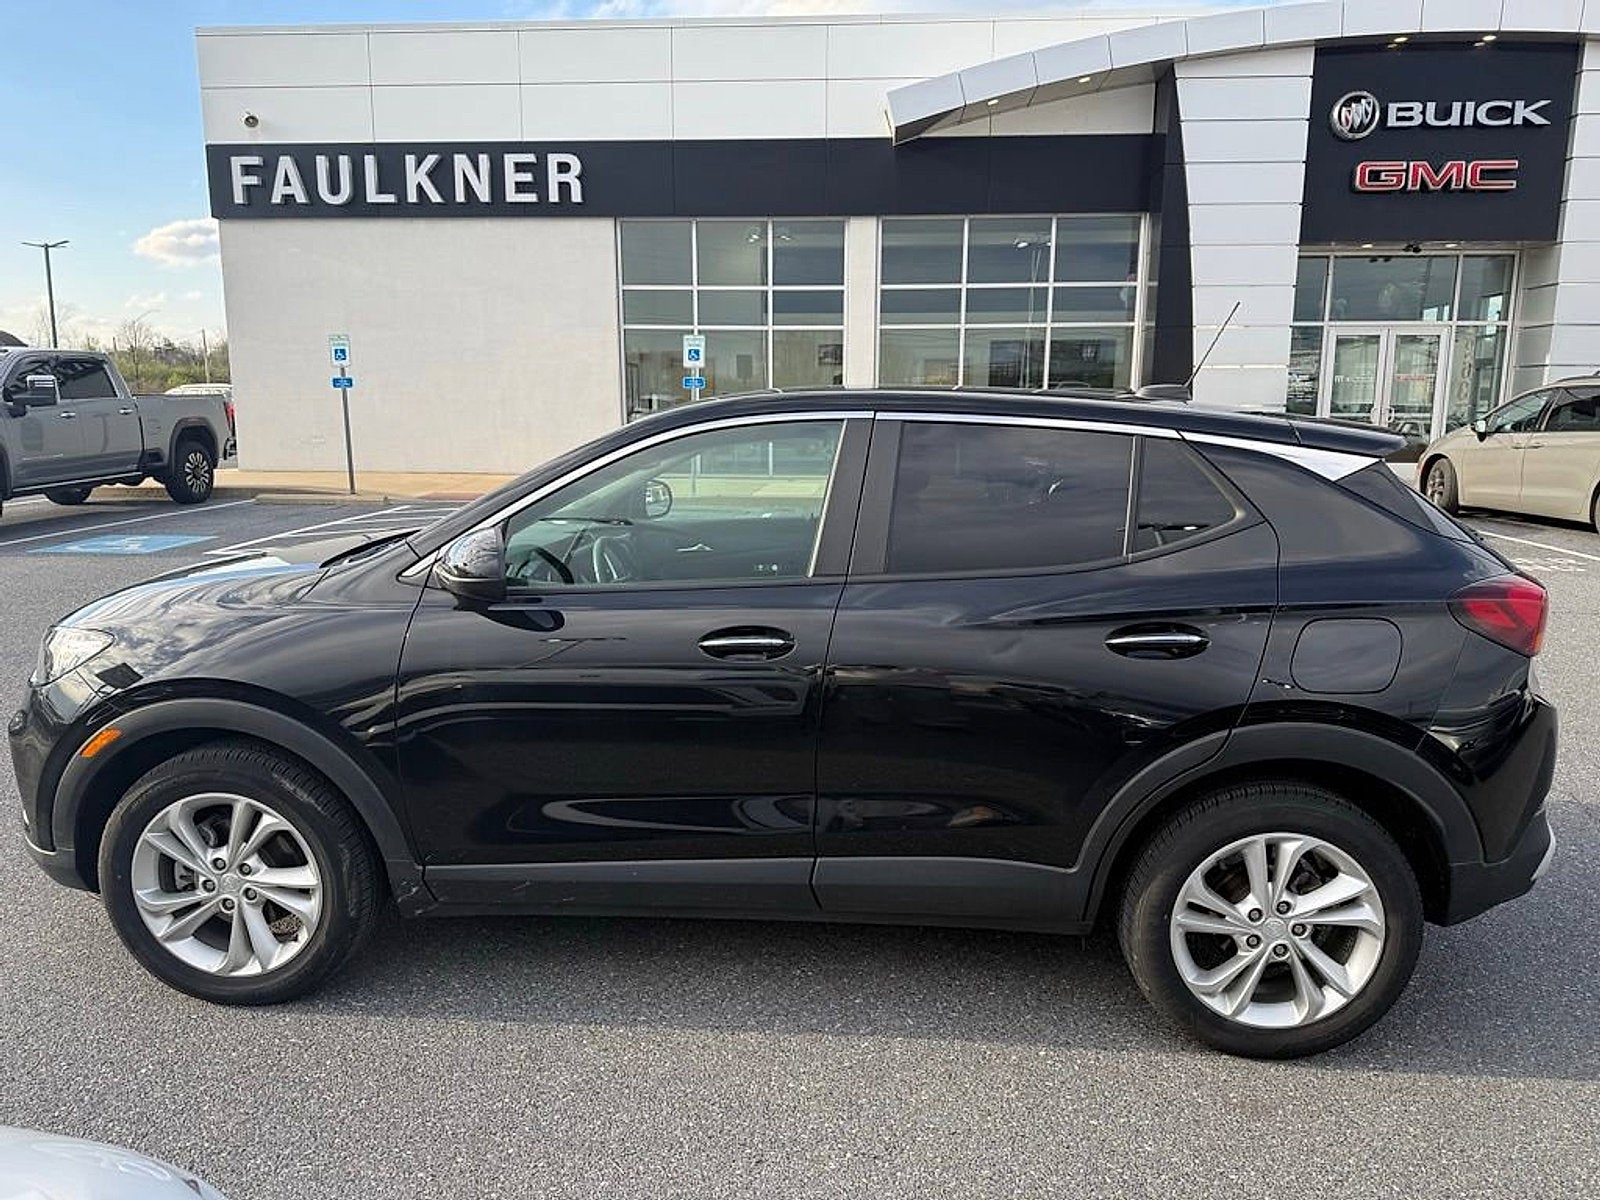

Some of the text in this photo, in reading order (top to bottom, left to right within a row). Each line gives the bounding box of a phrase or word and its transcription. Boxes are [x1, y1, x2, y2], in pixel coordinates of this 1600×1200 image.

[1386, 99, 1552, 128] BUICK
[230, 153, 584, 205] FAULKNER
[1354, 159, 1519, 191] GMC
